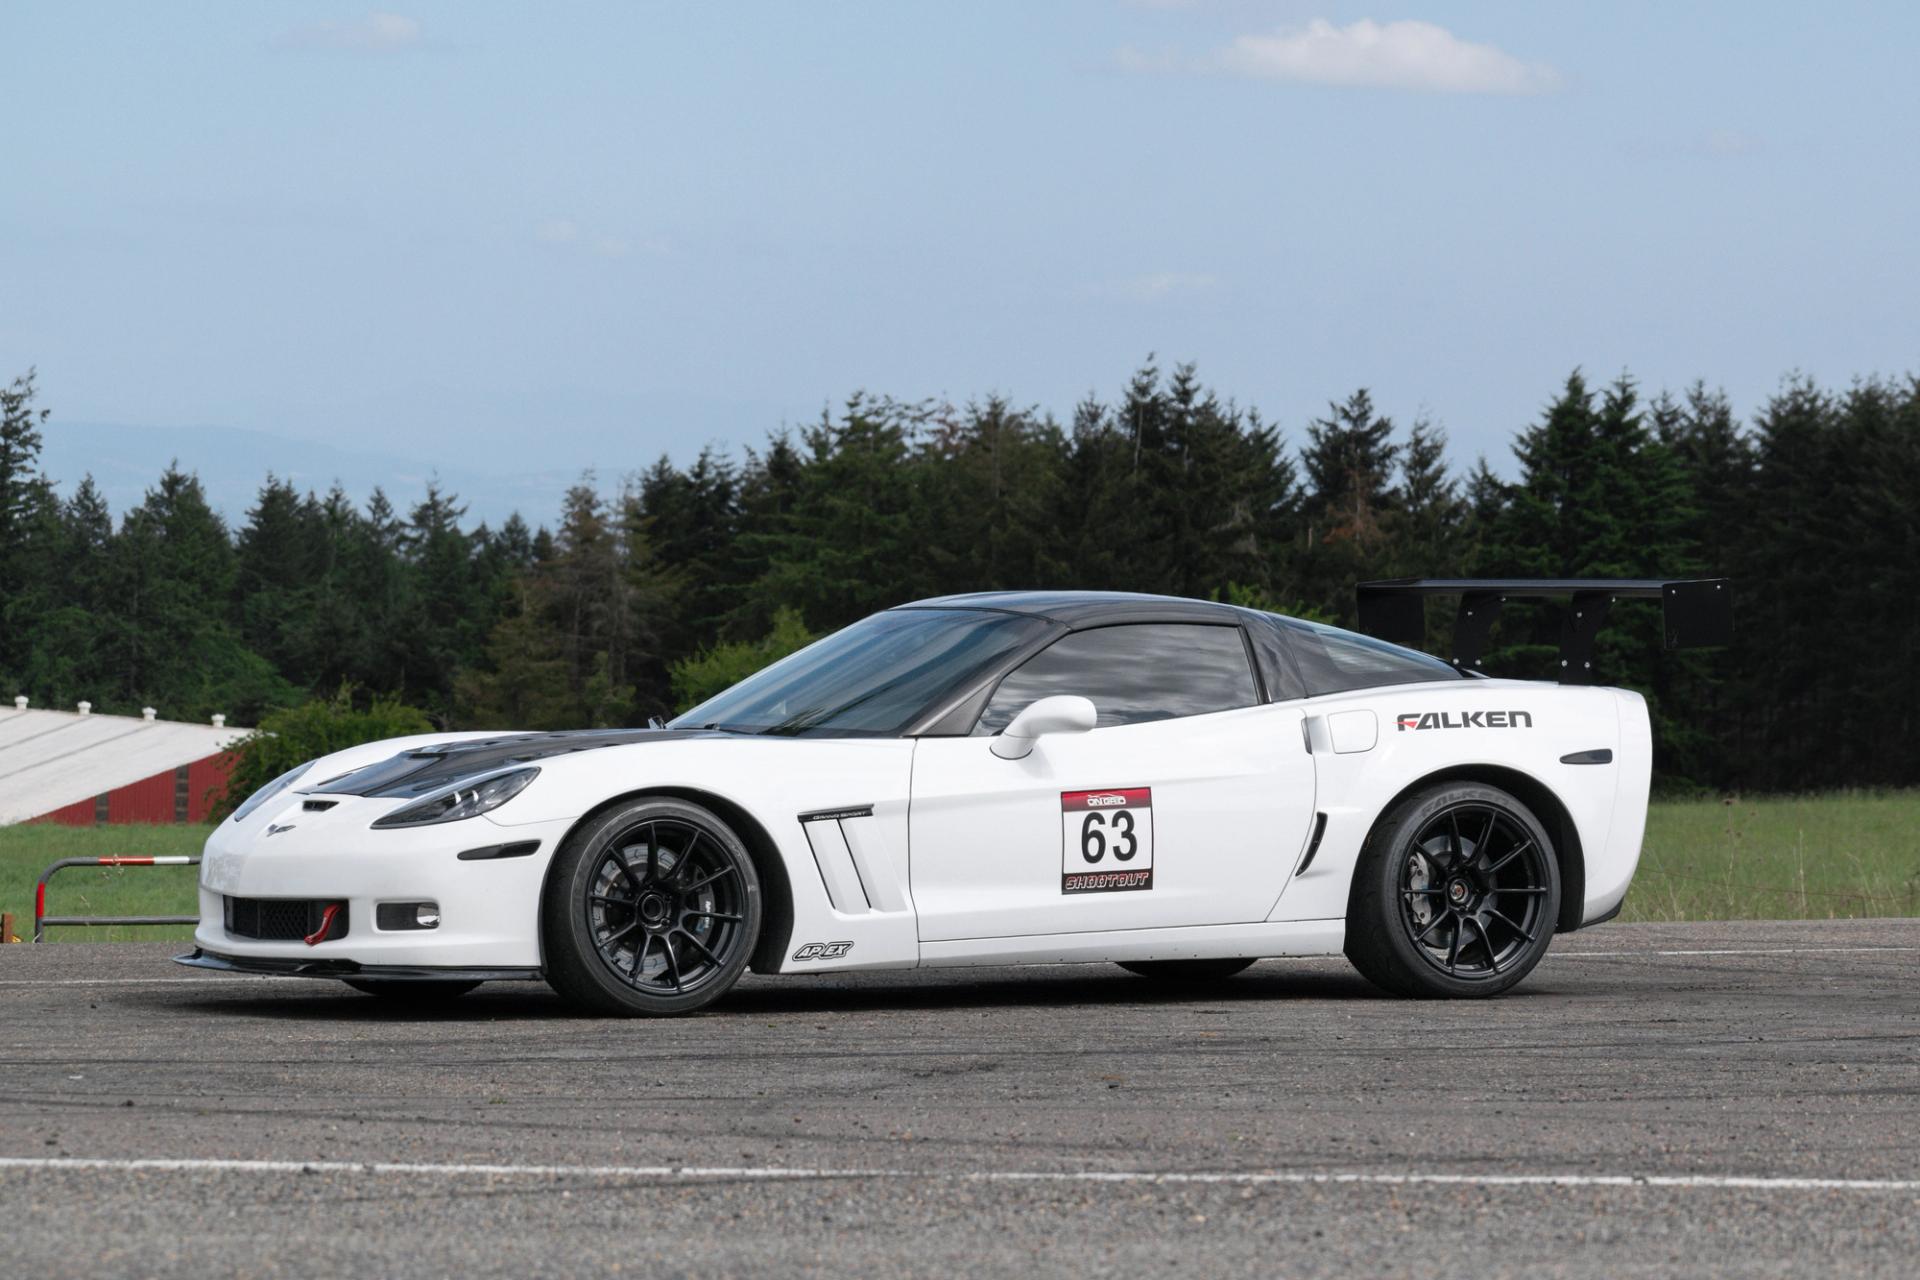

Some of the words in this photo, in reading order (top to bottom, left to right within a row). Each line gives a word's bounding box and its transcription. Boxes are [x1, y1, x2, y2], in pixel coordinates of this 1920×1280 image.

[1392, 711, 1533, 732] FALKEN
[1081, 810, 1138, 864] 63
[1065, 872, 1150, 890] SHOOTOUT
[794, 942, 853, 960] APEX
